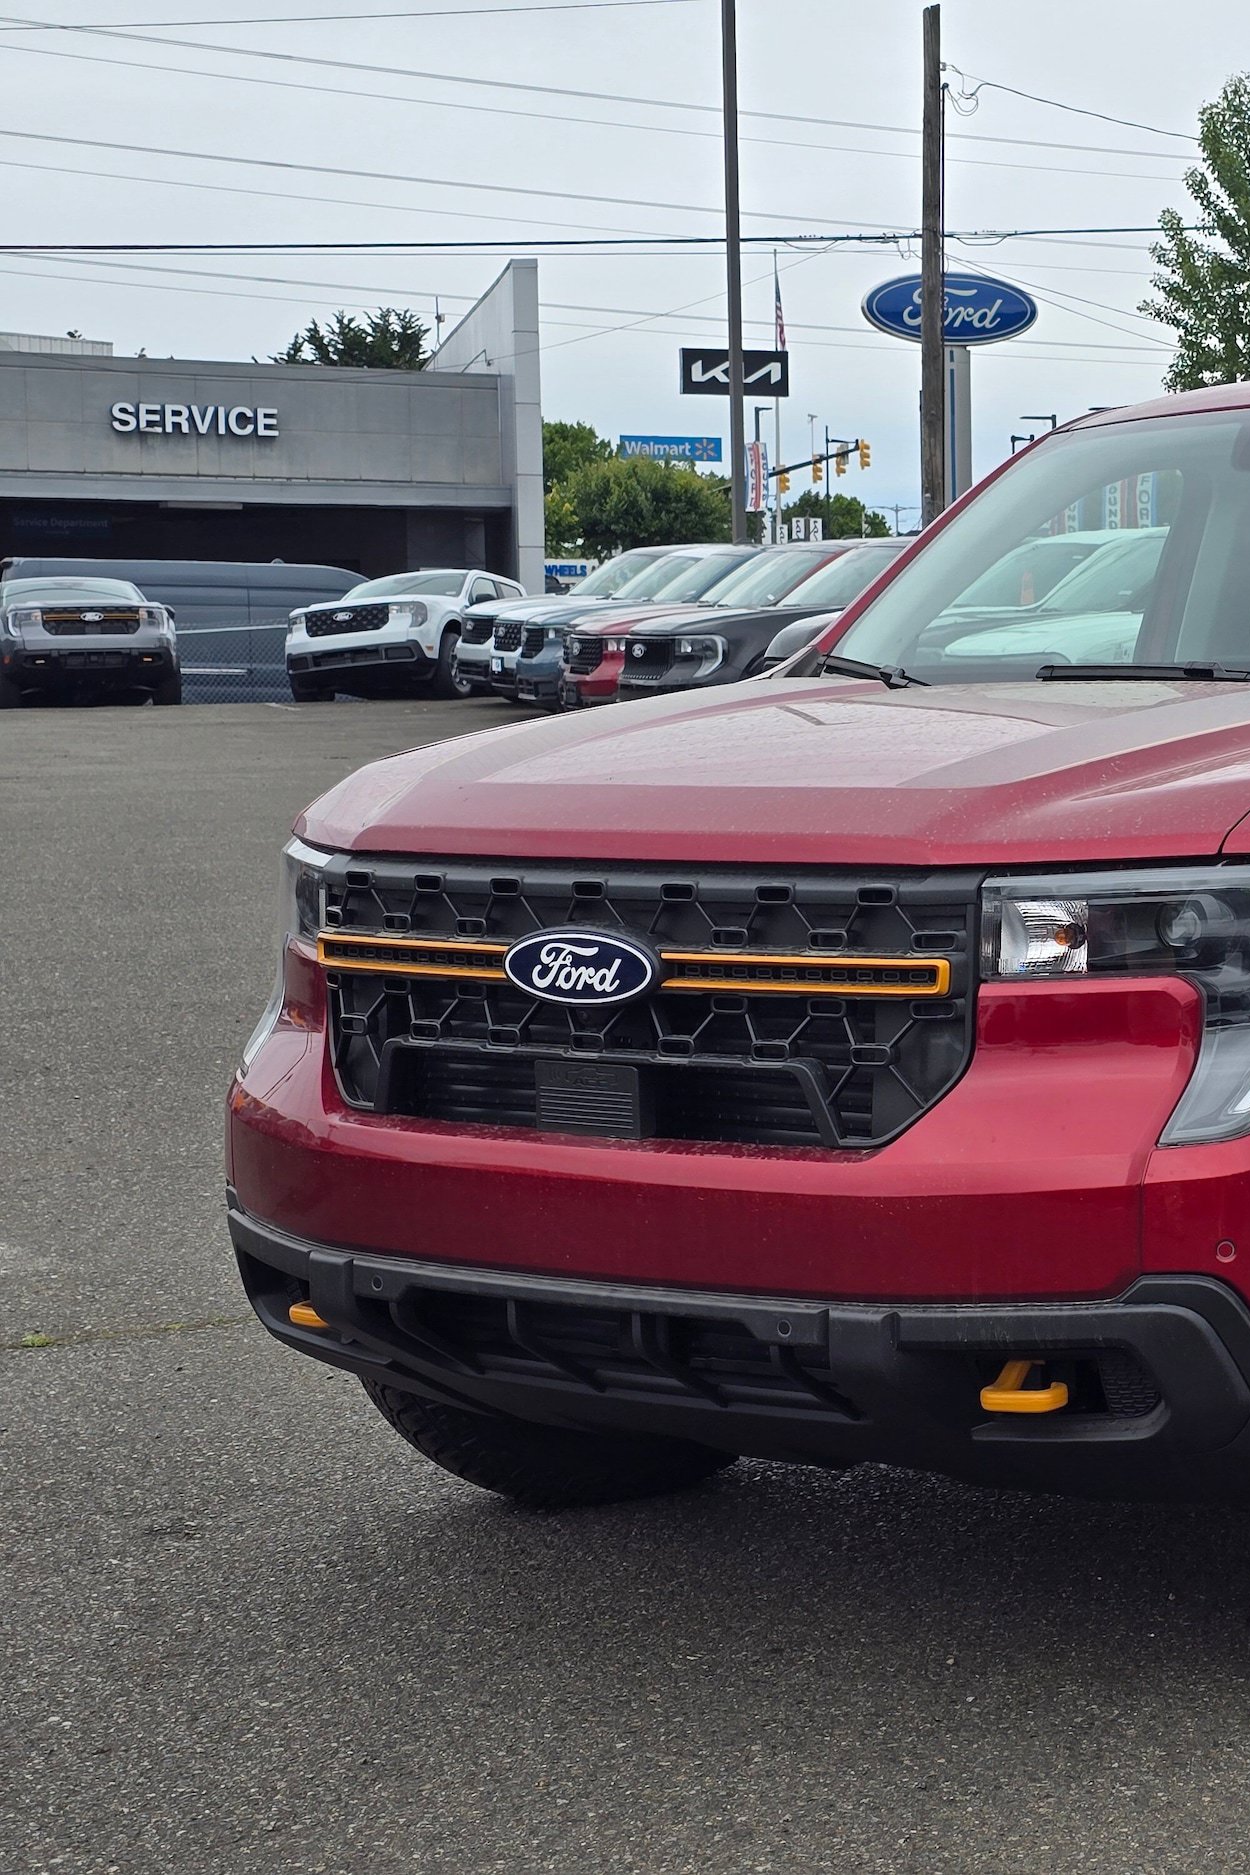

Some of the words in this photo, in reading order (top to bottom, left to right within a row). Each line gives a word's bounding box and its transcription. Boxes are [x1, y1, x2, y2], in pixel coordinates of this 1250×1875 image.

[691, 359, 782, 385] KA
[111, 402, 280, 437] SERVICE
[624, 440, 692, 456] Walmart
[12, 516, 48, 527] Service
[50, 516, 108, 529] Department
[544, 564, 587, 577] WHEELS
[531, 942, 622, 993] Ford
